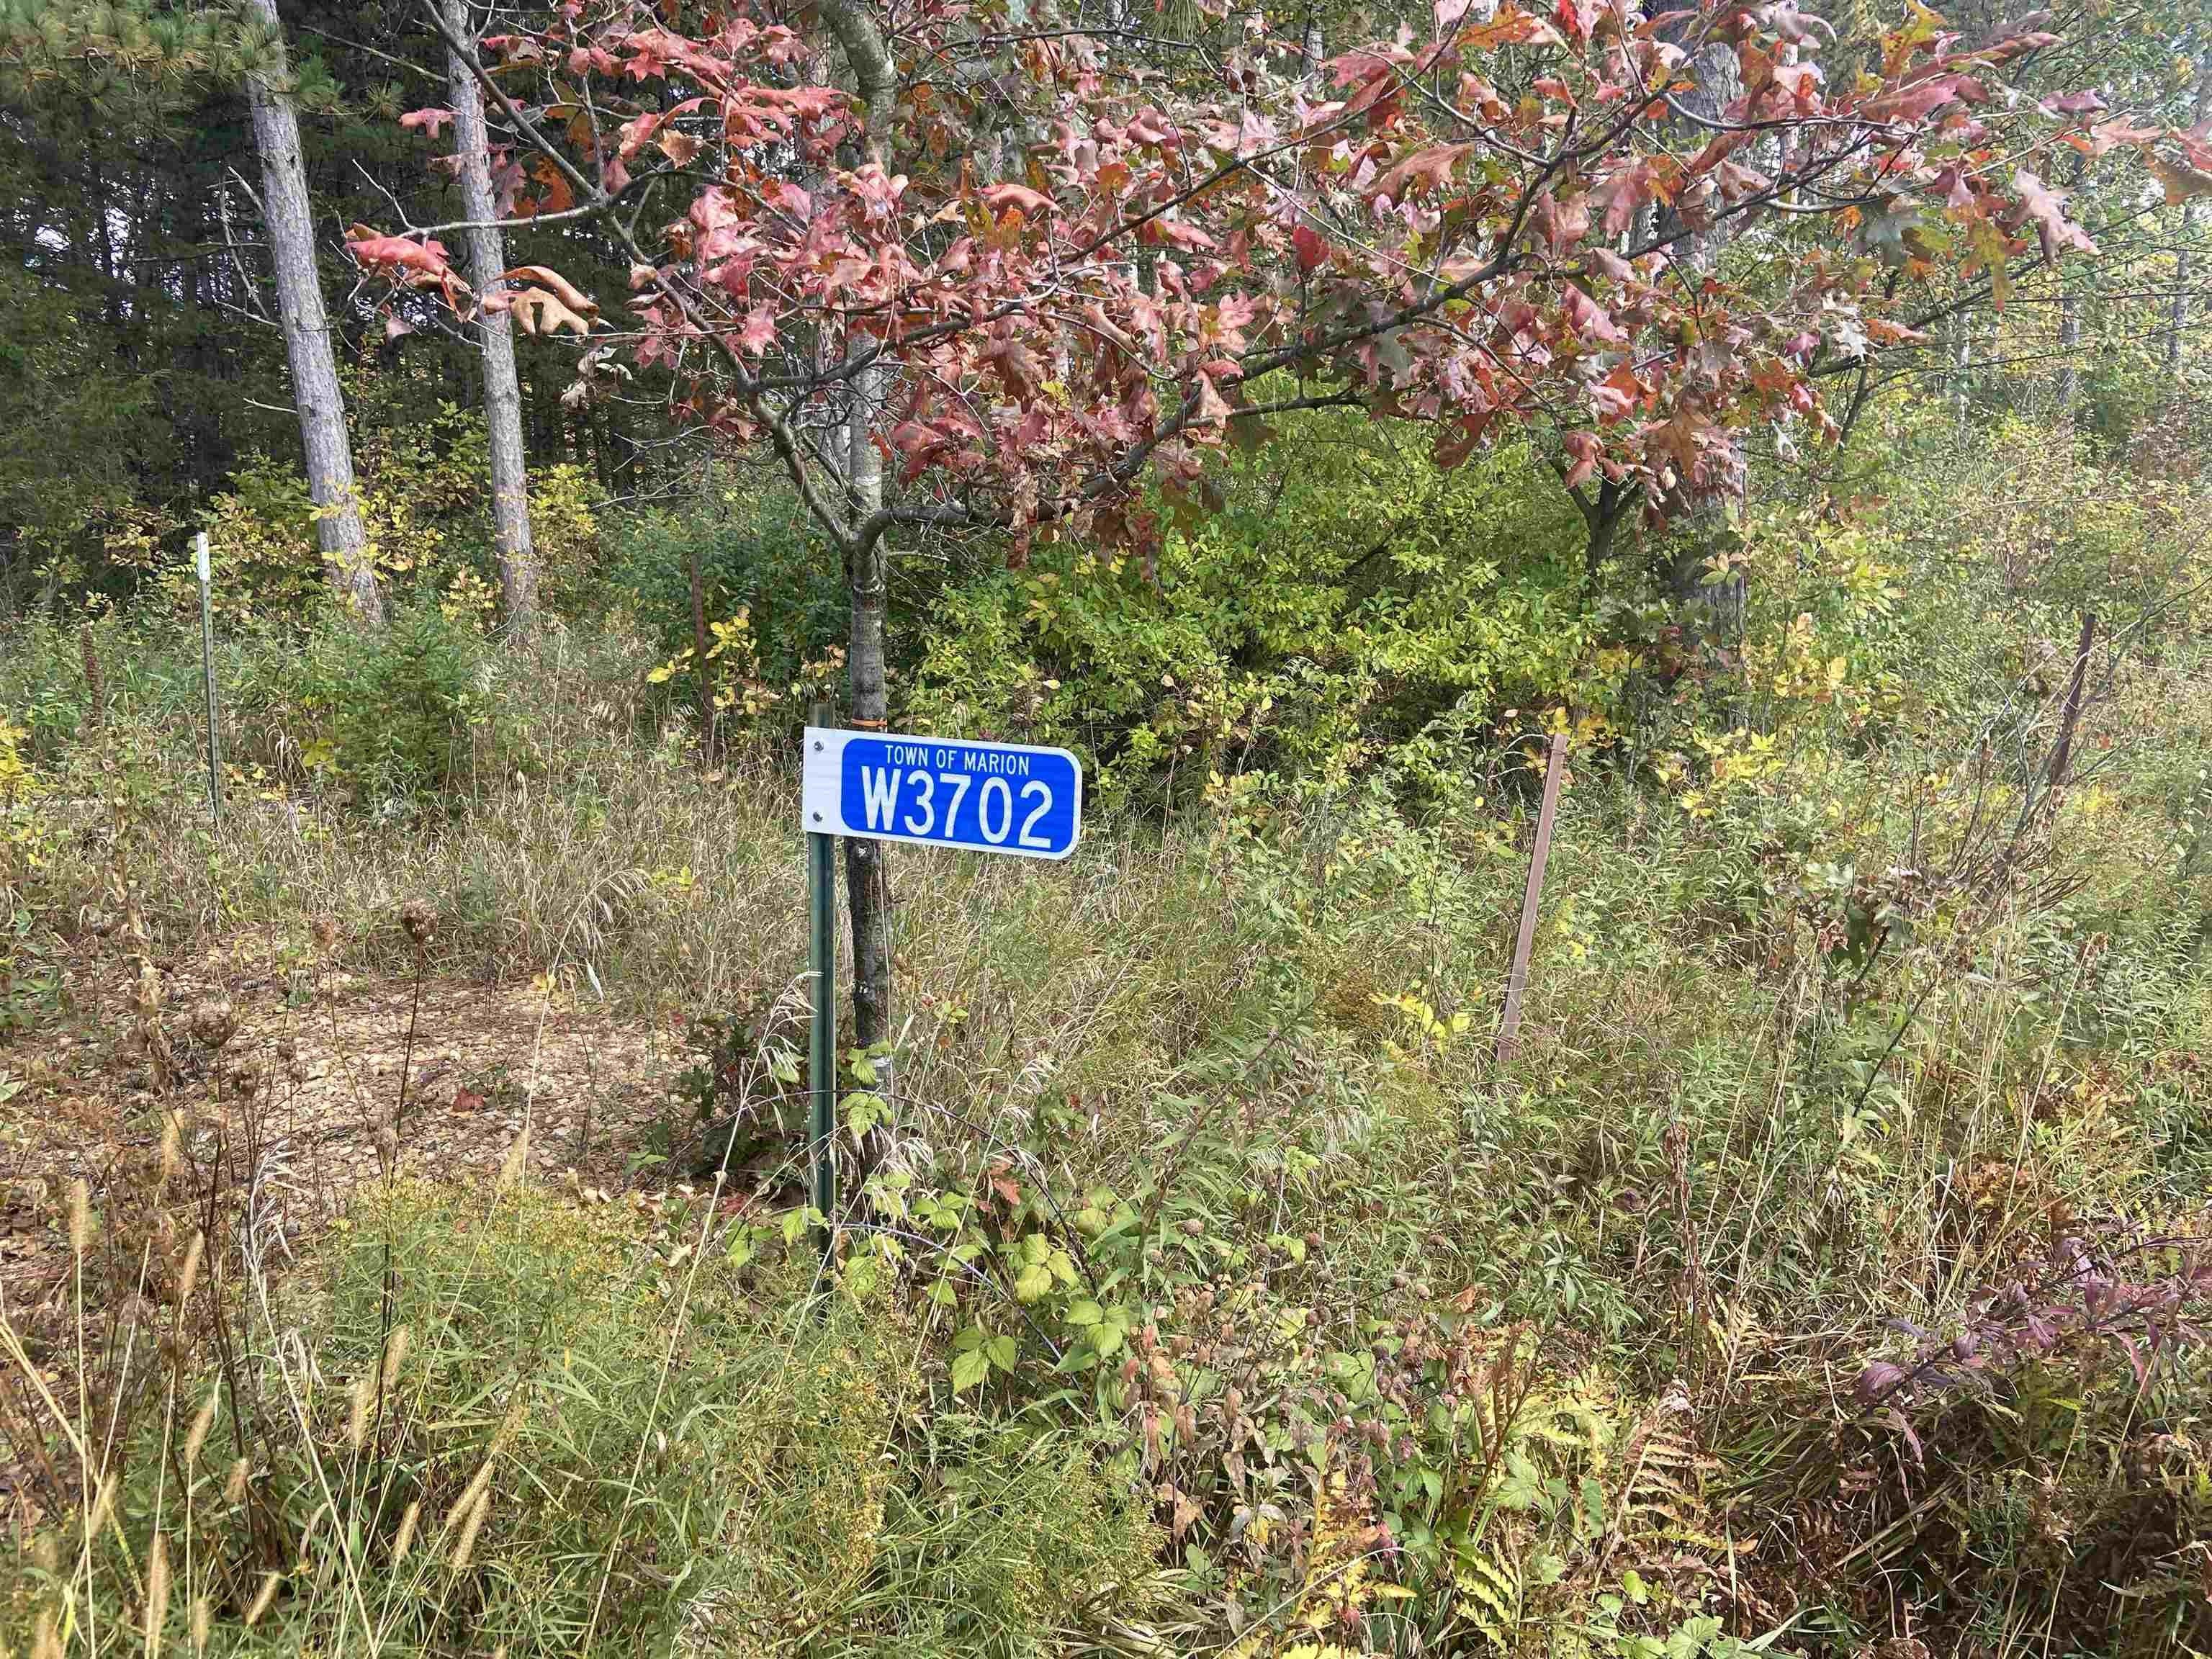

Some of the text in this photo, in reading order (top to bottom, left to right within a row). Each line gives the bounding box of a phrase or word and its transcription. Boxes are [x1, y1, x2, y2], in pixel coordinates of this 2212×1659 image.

[885, 745, 1029, 775] TOWN OF MARION
[862, 765, 1053, 849] W3702
